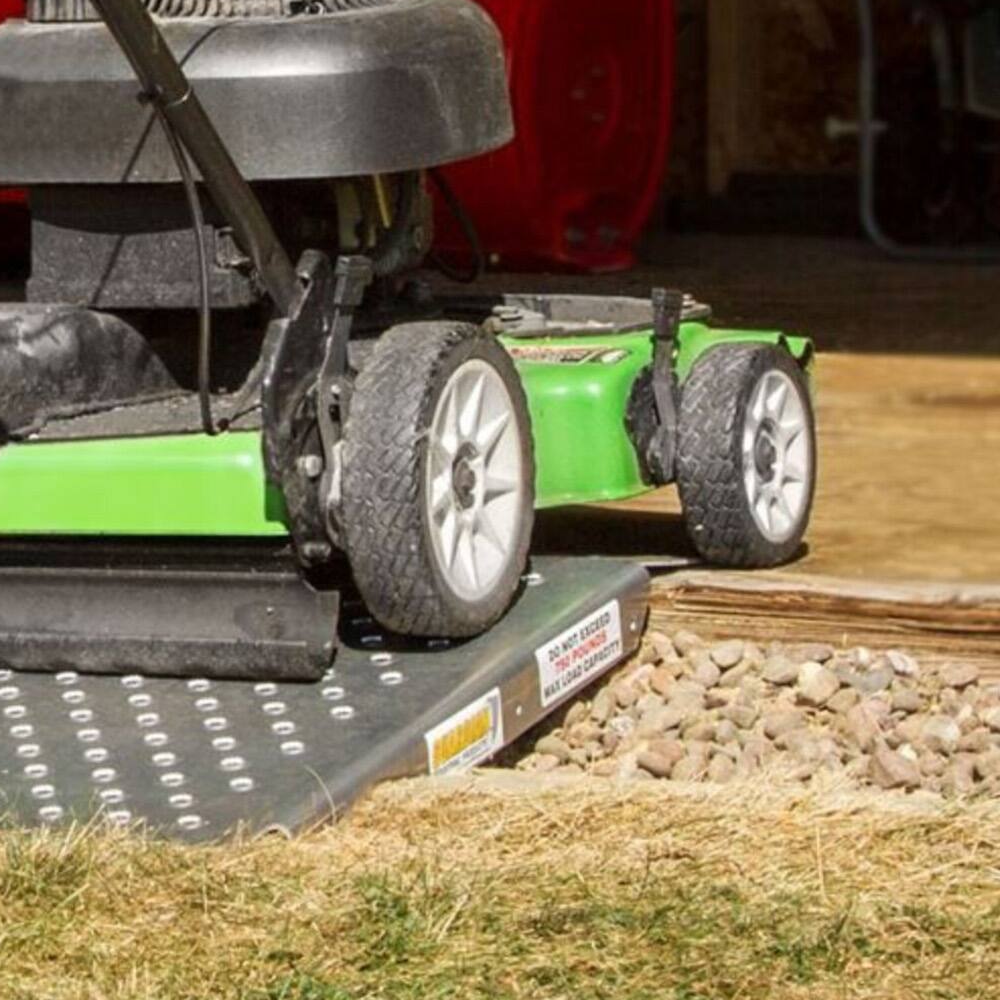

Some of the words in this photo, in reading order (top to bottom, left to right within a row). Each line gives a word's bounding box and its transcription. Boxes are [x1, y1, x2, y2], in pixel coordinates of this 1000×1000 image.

[548, 645, 560, 662] DO
[561, 632, 578, 653] NOT
[579, 611, 610, 640] EXCEED
[572, 629, 607, 662] POUNDS
[562, 664, 582, 687] LOAD
[583, 639, 619, 672] CAPACITY
